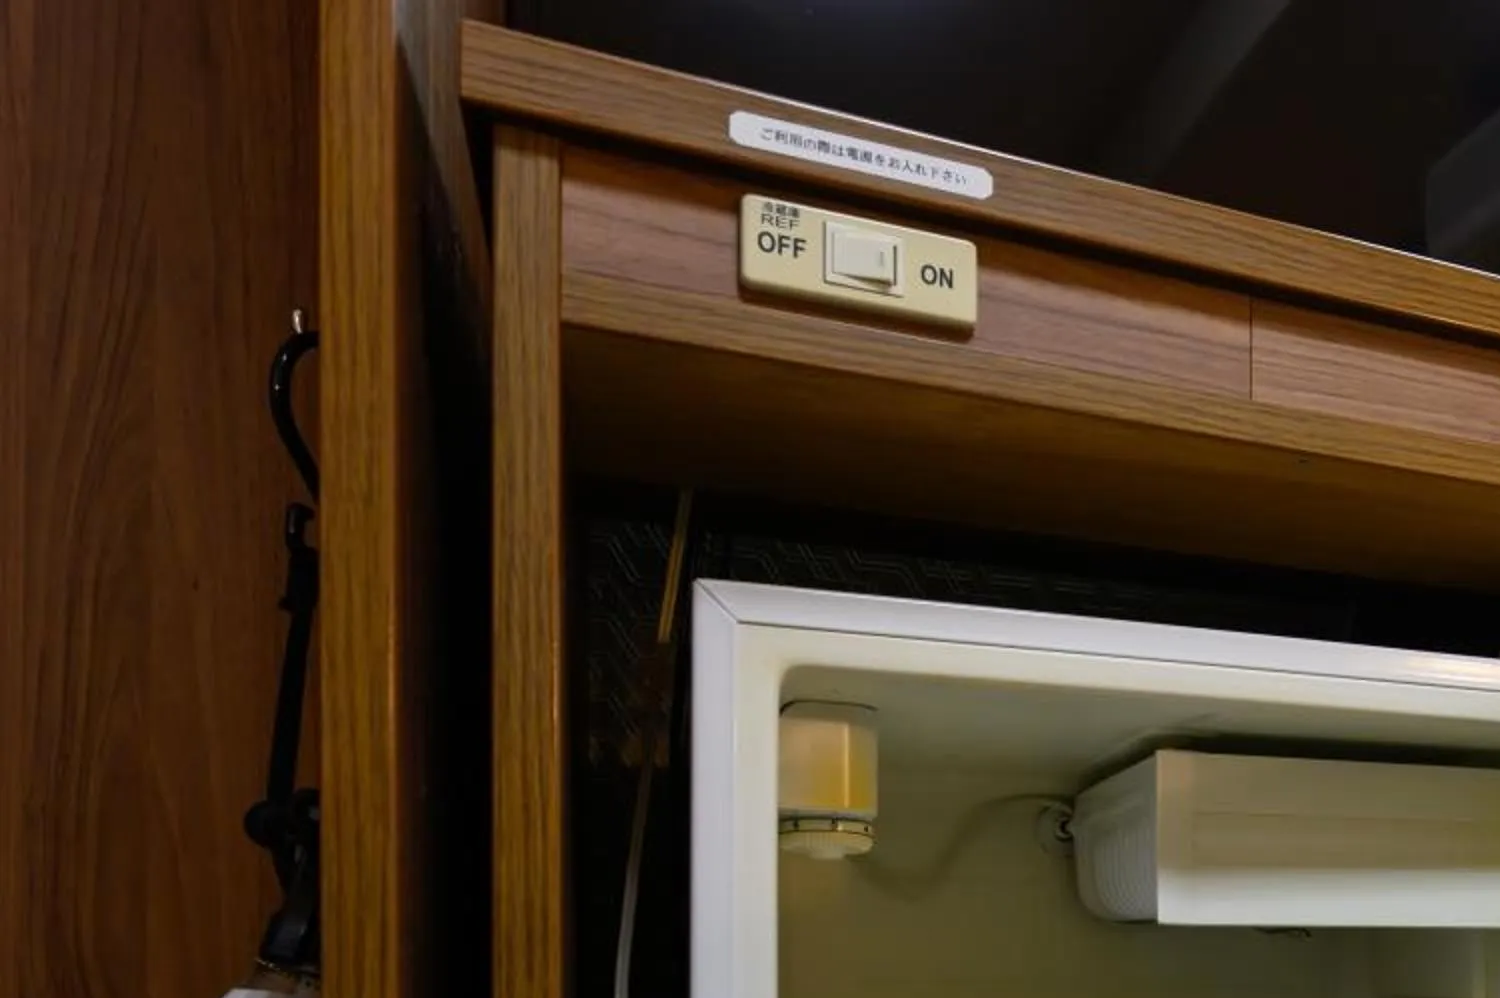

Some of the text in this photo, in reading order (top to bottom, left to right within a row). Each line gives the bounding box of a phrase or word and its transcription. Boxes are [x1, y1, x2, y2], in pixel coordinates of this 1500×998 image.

[760, 128, 968, 186] ご利用の際は電源をお入れ下さい
[761, 213, 800, 231] REF
[757, 231, 807, 259] OFF
[921, 264, 954, 289] ON
